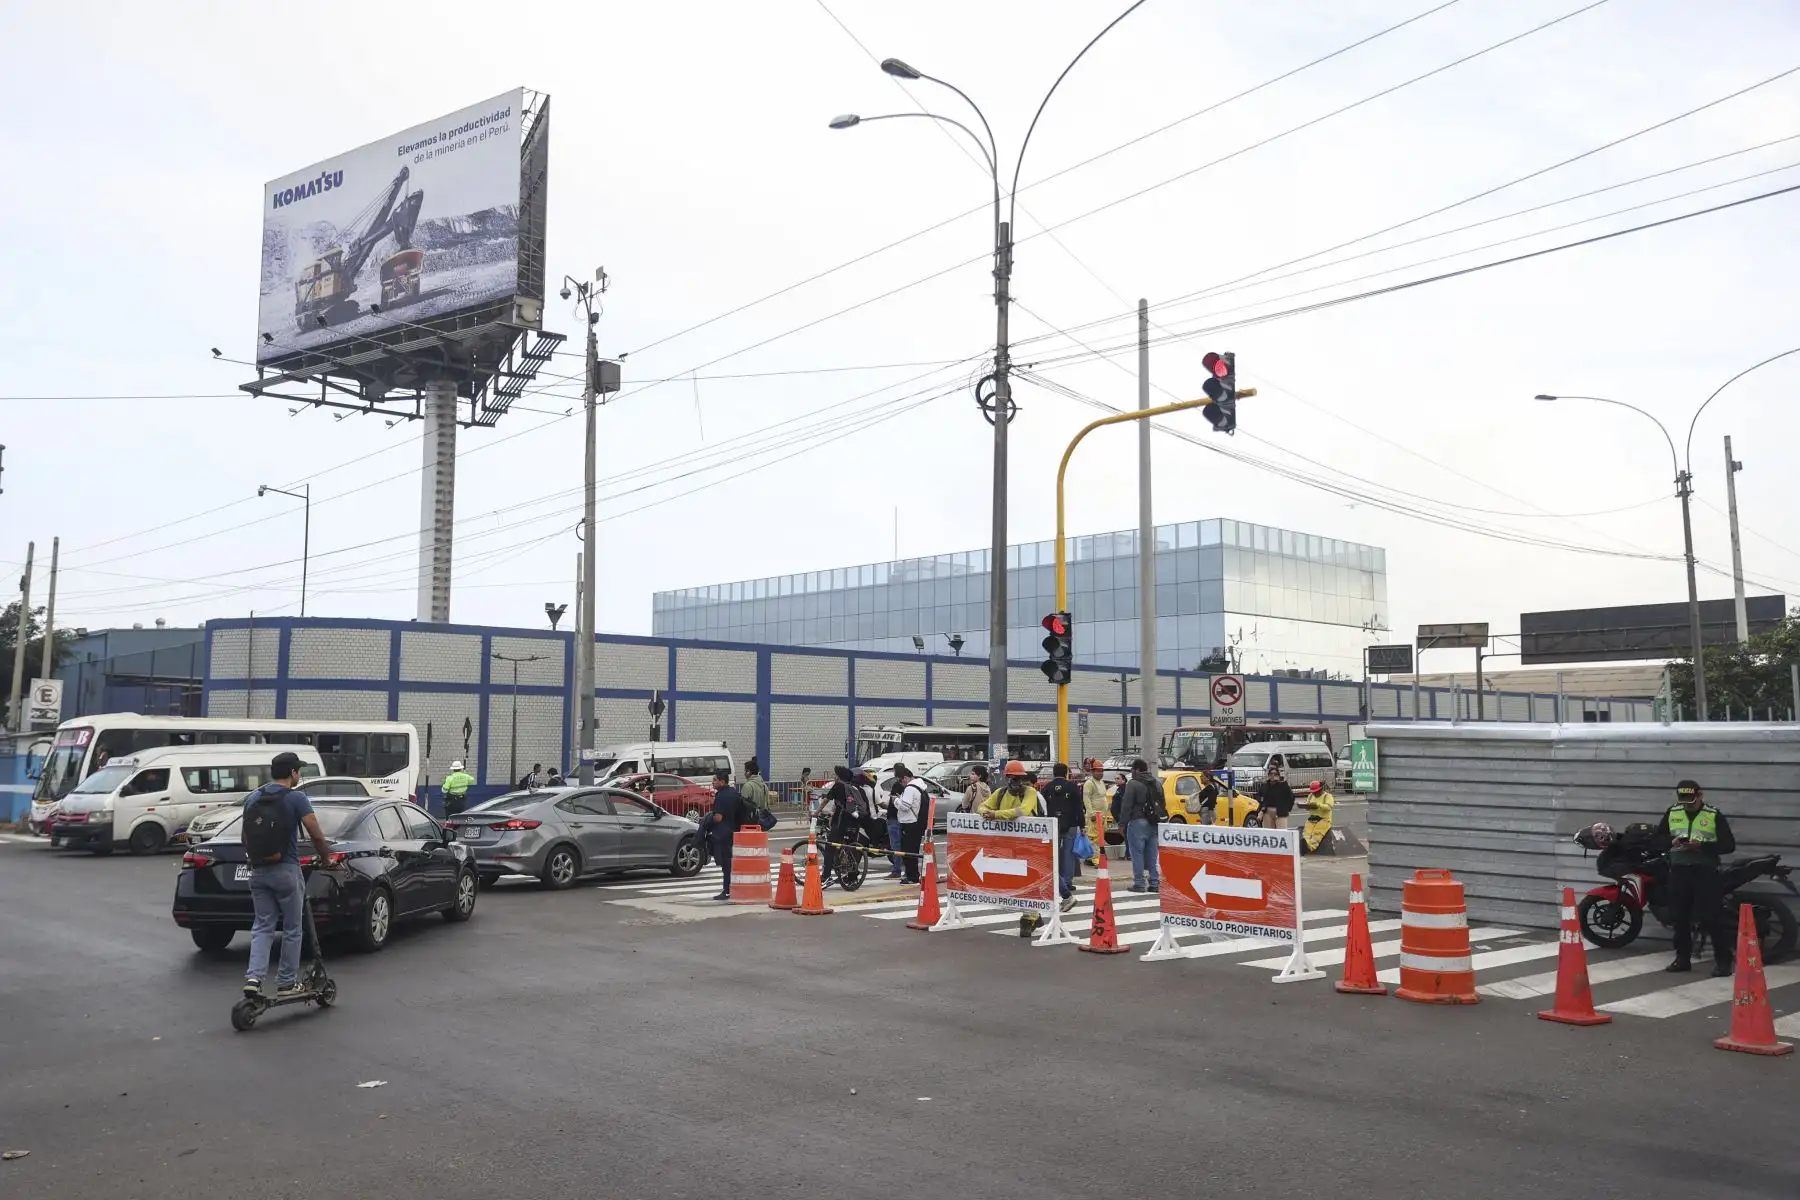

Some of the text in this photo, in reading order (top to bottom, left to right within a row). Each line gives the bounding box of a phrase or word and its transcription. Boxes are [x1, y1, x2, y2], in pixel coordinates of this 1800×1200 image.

[398, 106, 511, 157] Elevamos la productividad
[413, 153, 425, 164] de
[426, 149, 433, 160] la
[467, 134, 478, 146] en
[479, 130, 487, 141] el
[273, 170, 343, 209] KOMATSU
[40, 688, 53, 702] E
[1213, 716, 1243, 724] CAMIONES
[76, 730, 90, 745] B
[950, 818, 1049, 834] CALLE CLAUSURADA
[1162, 829, 1288, 849] CALLE CLAUSURADA
[949, 891, 1051, 911] ACCESO SOLO PROPIETARIOS
[1163, 915, 1293, 940] ACCESO SOLO PROPIETARIOS
